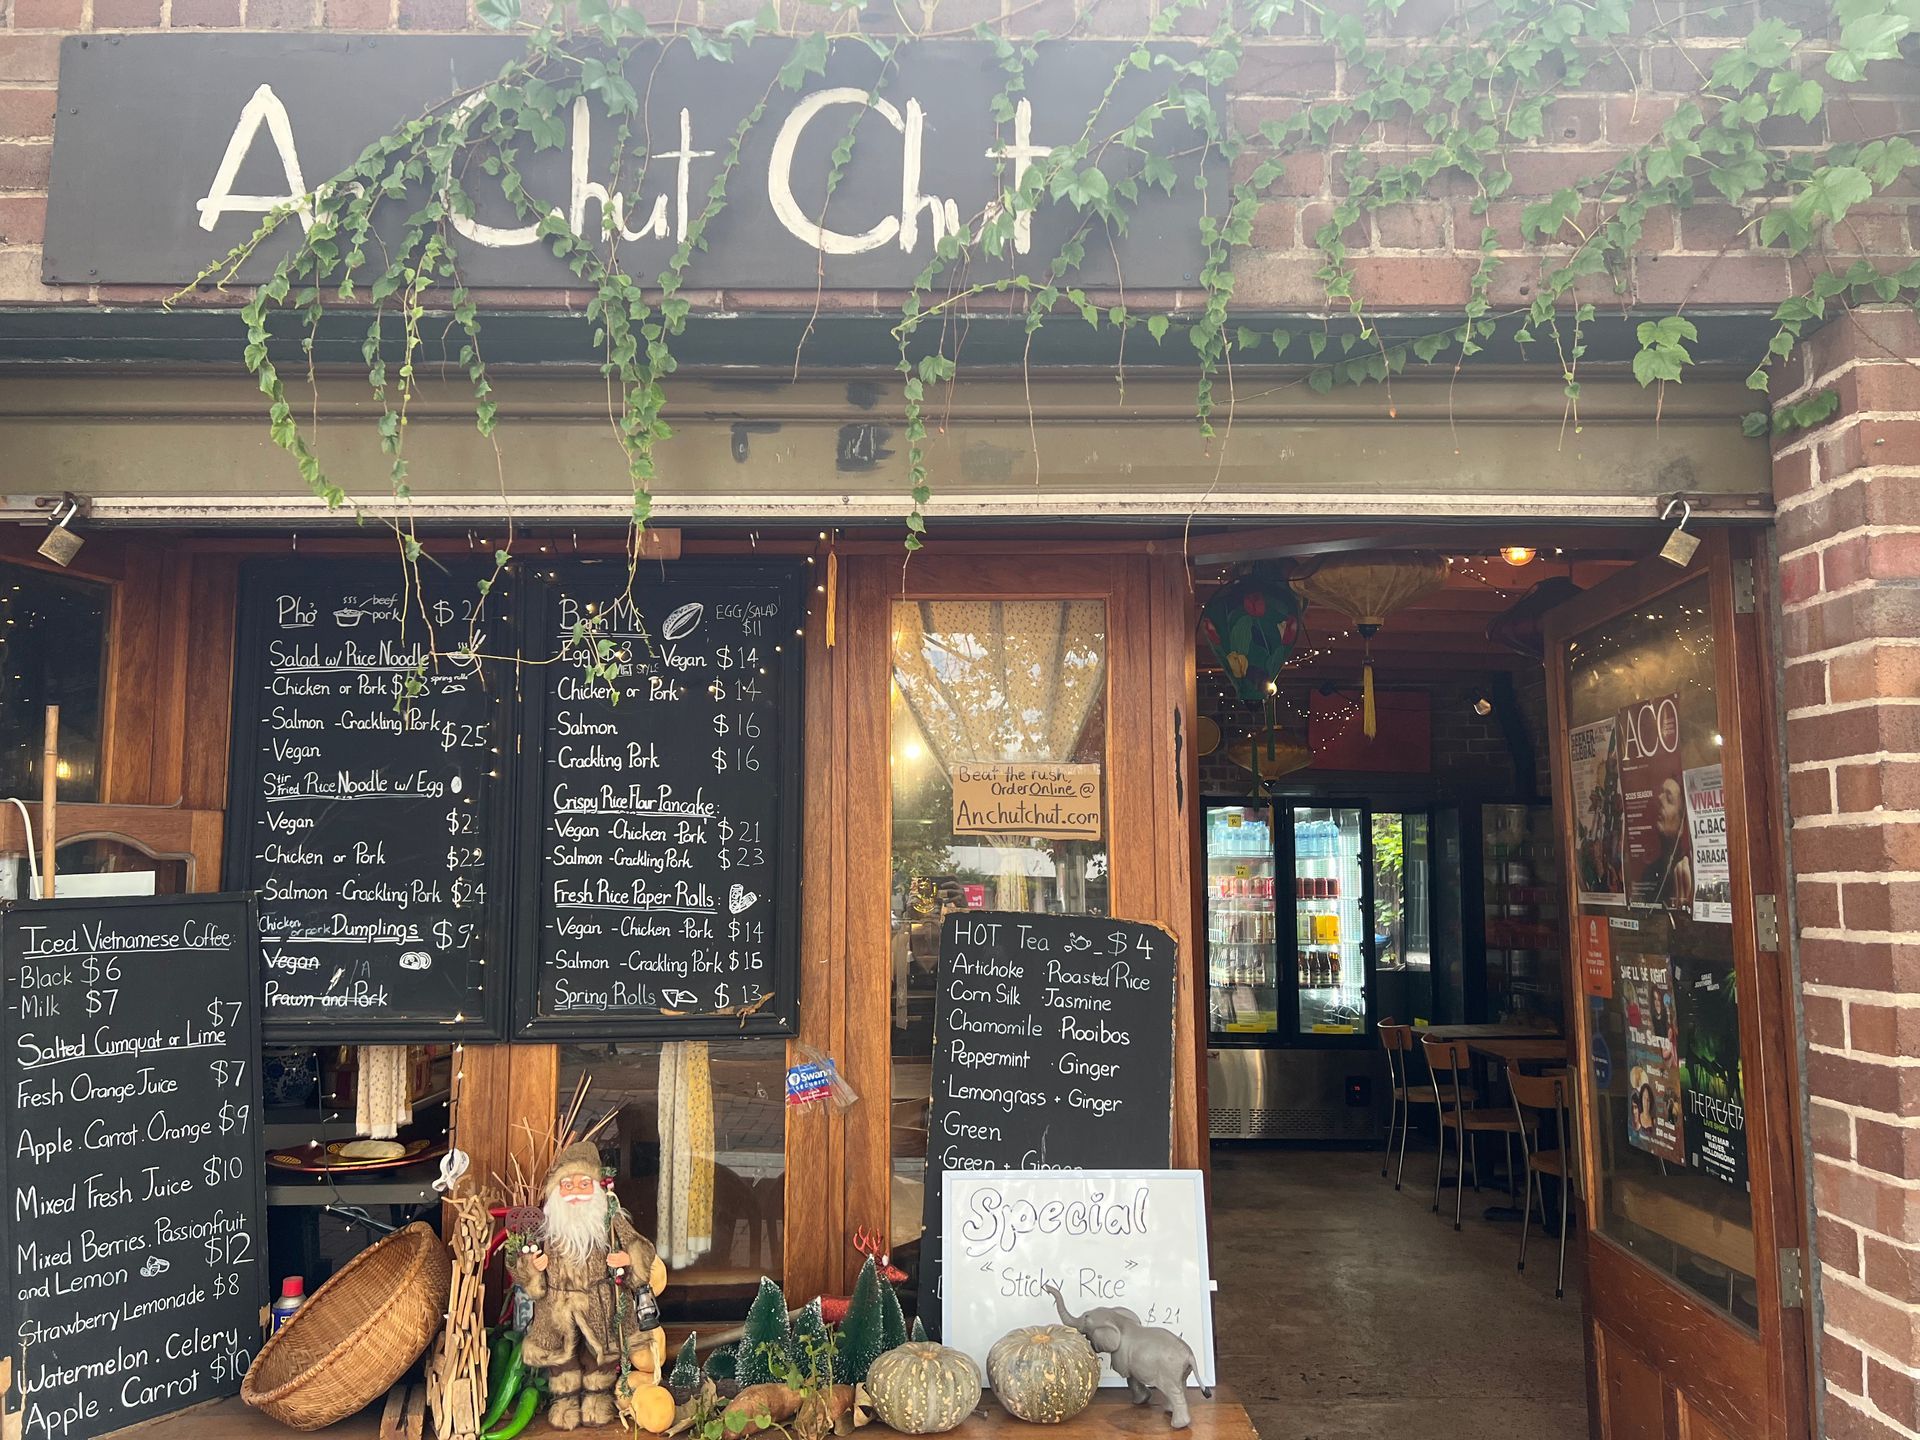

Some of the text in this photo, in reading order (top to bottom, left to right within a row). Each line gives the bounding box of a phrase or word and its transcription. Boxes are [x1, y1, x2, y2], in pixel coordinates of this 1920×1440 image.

[372, 609, 402, 623] pork
[742, 618, 762, 637] $11
[269, 639, 430, 667] Salad Rice Noodle
[716, 645, 759, 670] $14
[339, 684, 352, 696] or
[356, 674, 387, 696] Pork
[626, 675, 762, 702] or Pork $14
[408, 708, 441, 732] Pork
[440, 721, 490, 752] $25
[713, 711, 761, 738] $16
[1622, 698, 1679, 761] ACO
[626, 742, 660, 769] Pork
[712, 745, 760, 774] $16
[303, 770, 444, 798] Rice Noodle Egg
[958, 765, 999, 783] Beat
[1004, 766, 1026, 783] the
[553, 783, 598, 814] Crispy
[600, 784, 628, 809] Rice
[628, 784, 658, 810] Flour
[991, 782, 1096, 798] Order Online @
[956, 800, 1099, 827] Anchutchut.com
[717, 817, 760, 845] $21
[333, 853, 347, 864] or
[352, 841, 386, 865] Pork
[664, 848, 693, 869] Pork
[717, 847, 765, 871] $23
[410, 879, 442, 903] Pork
[451, 880, 487, 905] $24
[554, 878, 594, 904] Fresh
[596, 878, 629, 905] Rice
[631, 879, 672, 911] Paper
[19, 920, 180, 956] Iced Vietnamese
[259, 913, 419, 945] Chicken or pork Dumplings
[727, 917, 764, 943] $14
[954, 920, 1002, 947] HOT
[1016, 924, 1050, 951] Tea
[80, 954, 122, 987] $6
[262, 948, 321, 975] Vegan
[692, 949, 724, 974] Pork
[952, 952, 1150, 991] Artichoke Roasted Rice
[85, 988, 119, 1018] $7
[265, 980, 388, 1008] Prawn and Pork
[554, 978, 762, 1011] Spring Rolls $13
[950, 979, 1112, 1012] Corn Silk Jasmine
[206, 996, 243, 1028] $7
[949, 1008, 1131, 1046] Chamomile Rooibos
[17, 1019, 227, 1067] Salted Cumquat or Lime
[1629, 1026, 1672, 1051] The Servo
[951, 1039, 1120, 1081] Peppermint Ginger
[17, 1060, 246, 1109] Fresh Orange Juice $7
[948, 1074, 1123, 1118] Lemongrass Ginger
[147, 1100, 250, 1144] Orange $9
[943, 1110, 1002, 1142] Green
[942, 1145, 996, 1170] Green
[16, 1154, 243, 1222] Mixed Fresh Juice $10
[962, 1186, 1150, 1253] Special
[17, 1209, 247, 1275] Mixed Passionfruit
[18, 1232, 255, 1300] and Lemon $12
[1078, 1267, 1126, 1299] Rice
[18, 1272, 240, 1348] Strawberry Lemonade $8
[1145, 1302, 1180, 1327] $21
[120, 1348, 251, 1408] Carrot $10
